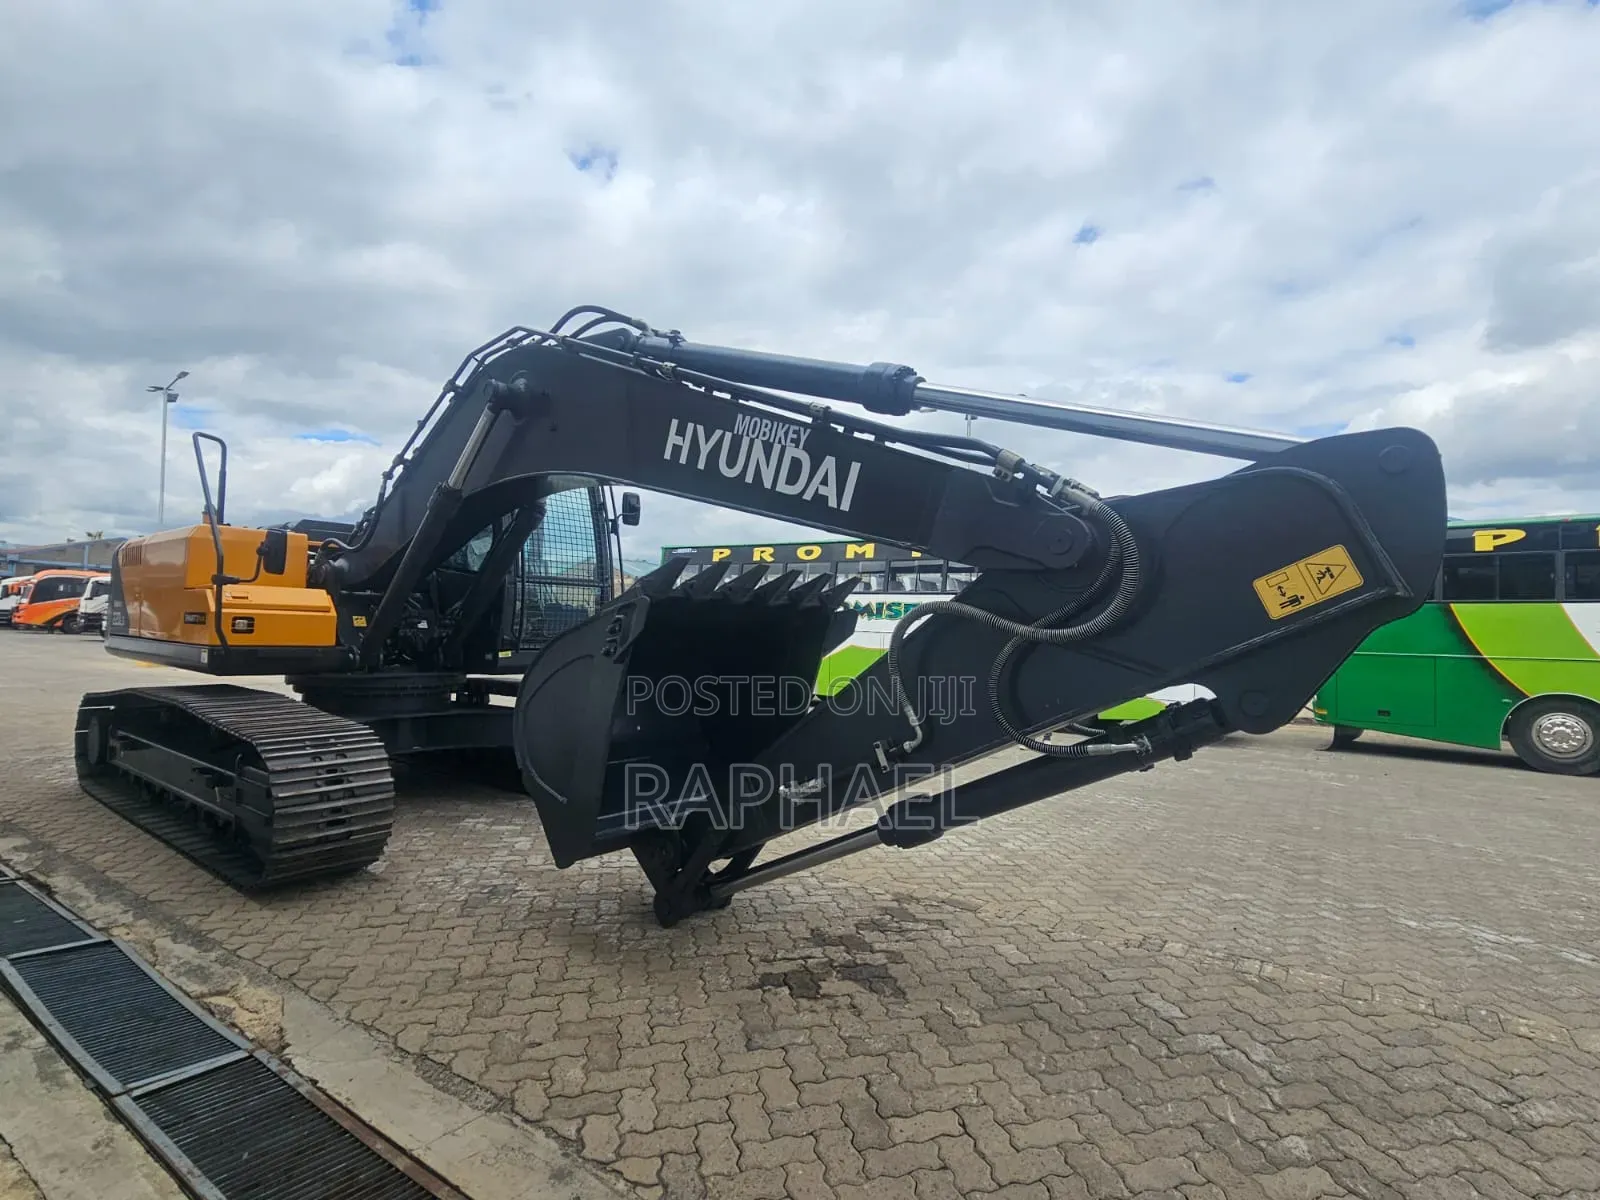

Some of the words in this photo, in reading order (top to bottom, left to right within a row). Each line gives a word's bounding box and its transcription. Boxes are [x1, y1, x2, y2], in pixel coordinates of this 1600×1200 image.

[733, 413, 812, 450] MOBIKEY
[663, 418, 862, 512] HYUNDAI
[712, 543, 922, 562] PROM
